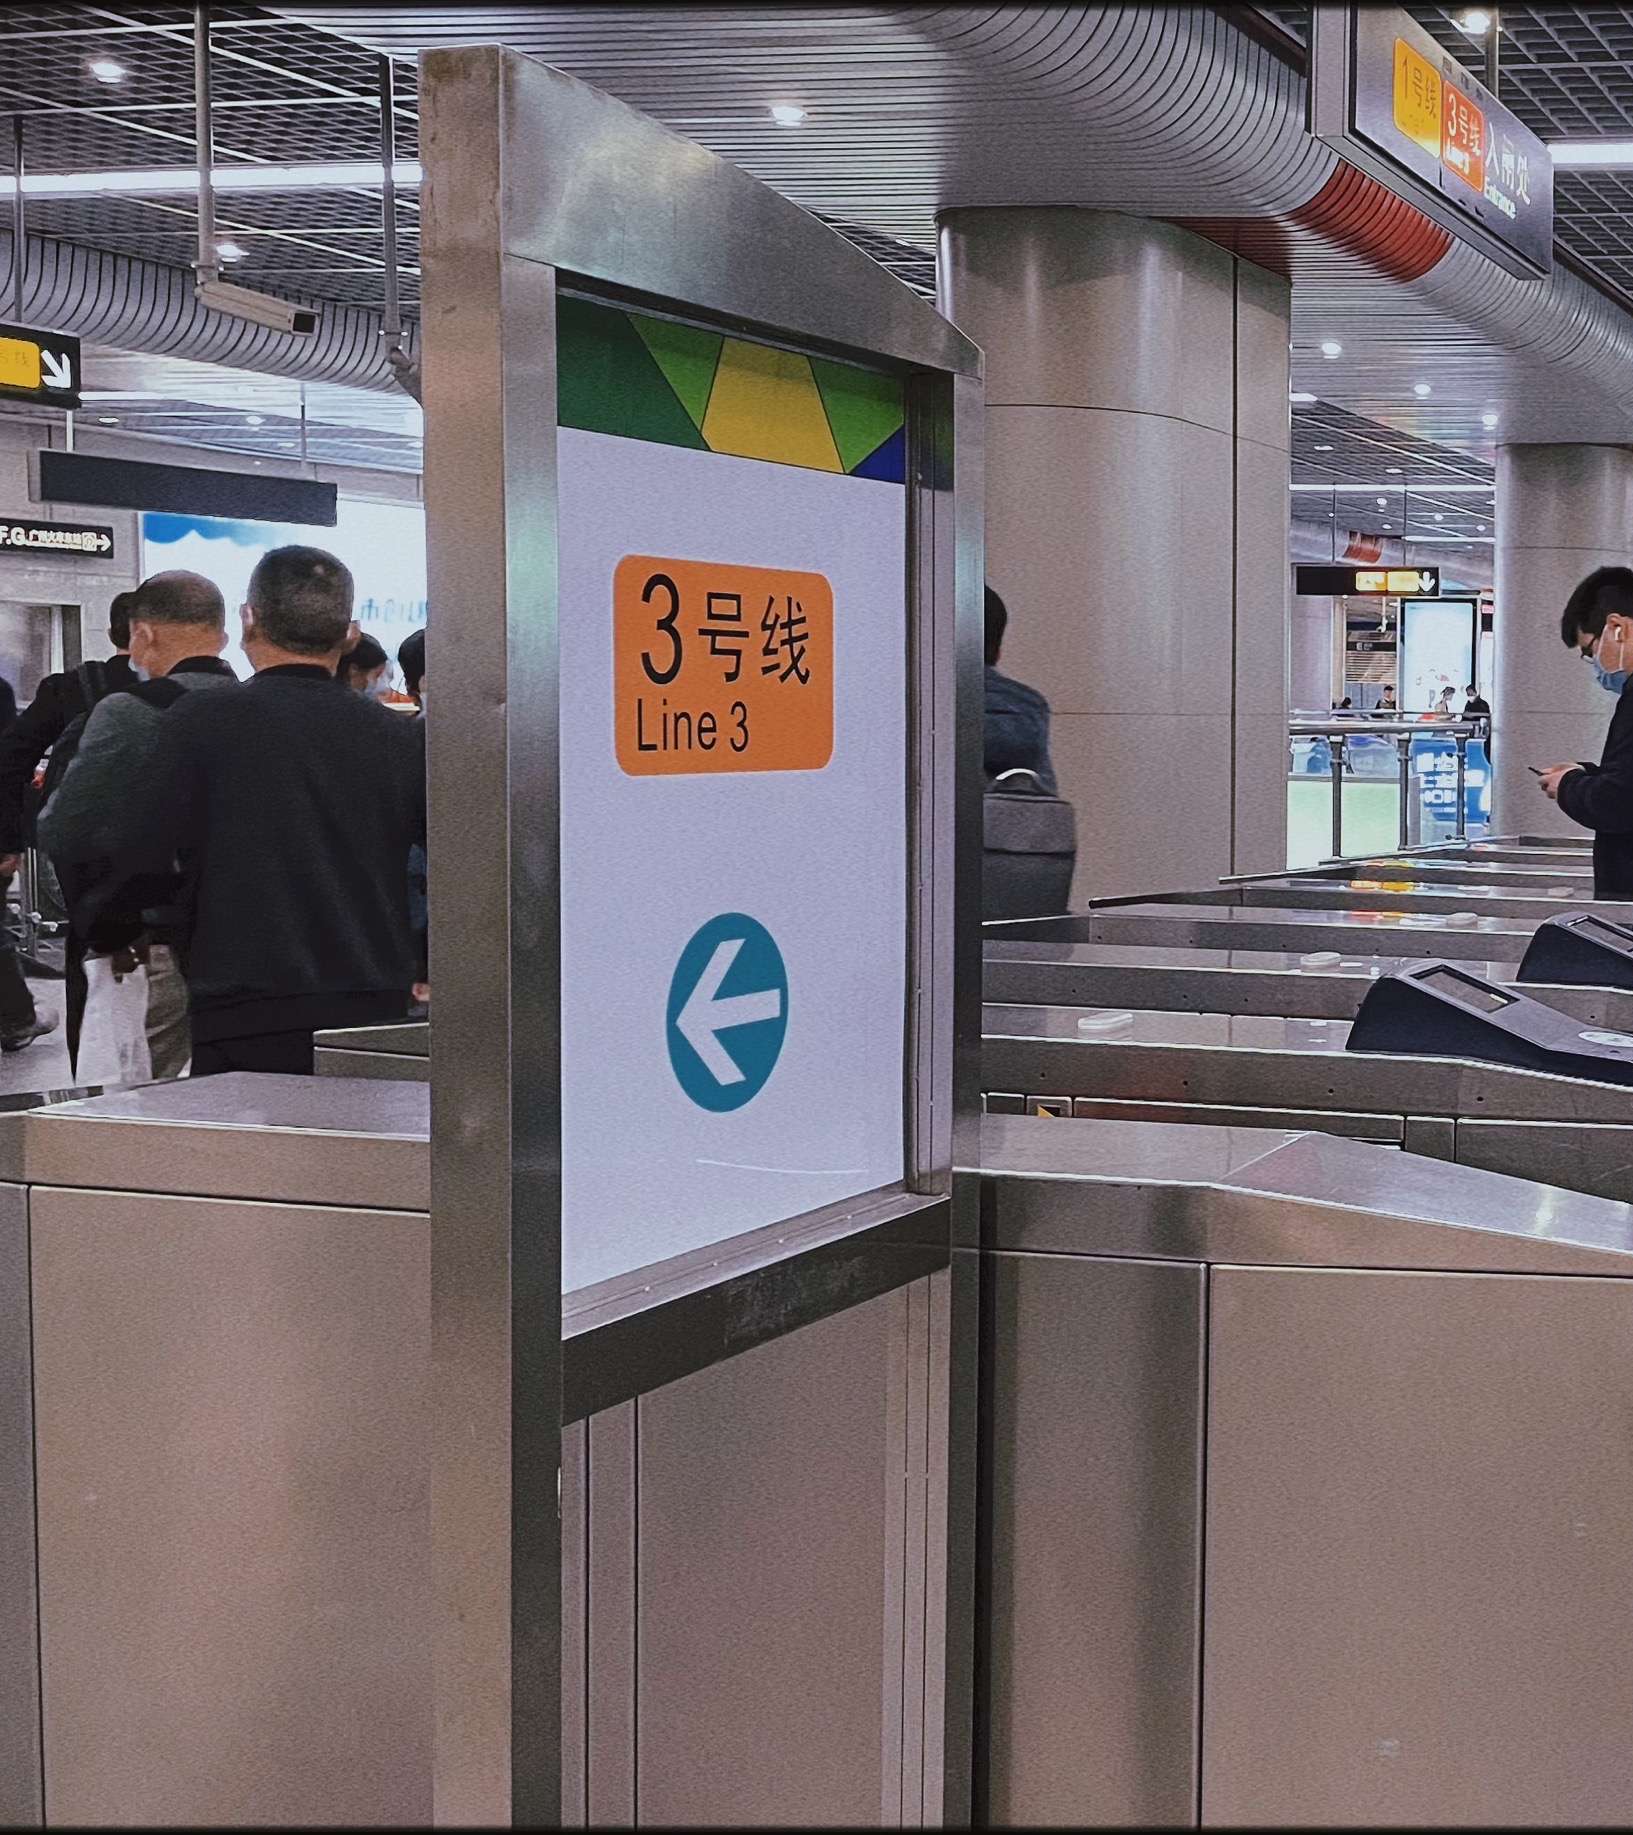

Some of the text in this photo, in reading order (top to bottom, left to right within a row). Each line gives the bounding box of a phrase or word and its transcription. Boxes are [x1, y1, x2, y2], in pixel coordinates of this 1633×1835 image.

[1448, 93, 1482, 156] 3号线
[640, 572, 811, 685] 3号线
[637, 697, 749, 753] Line 3
